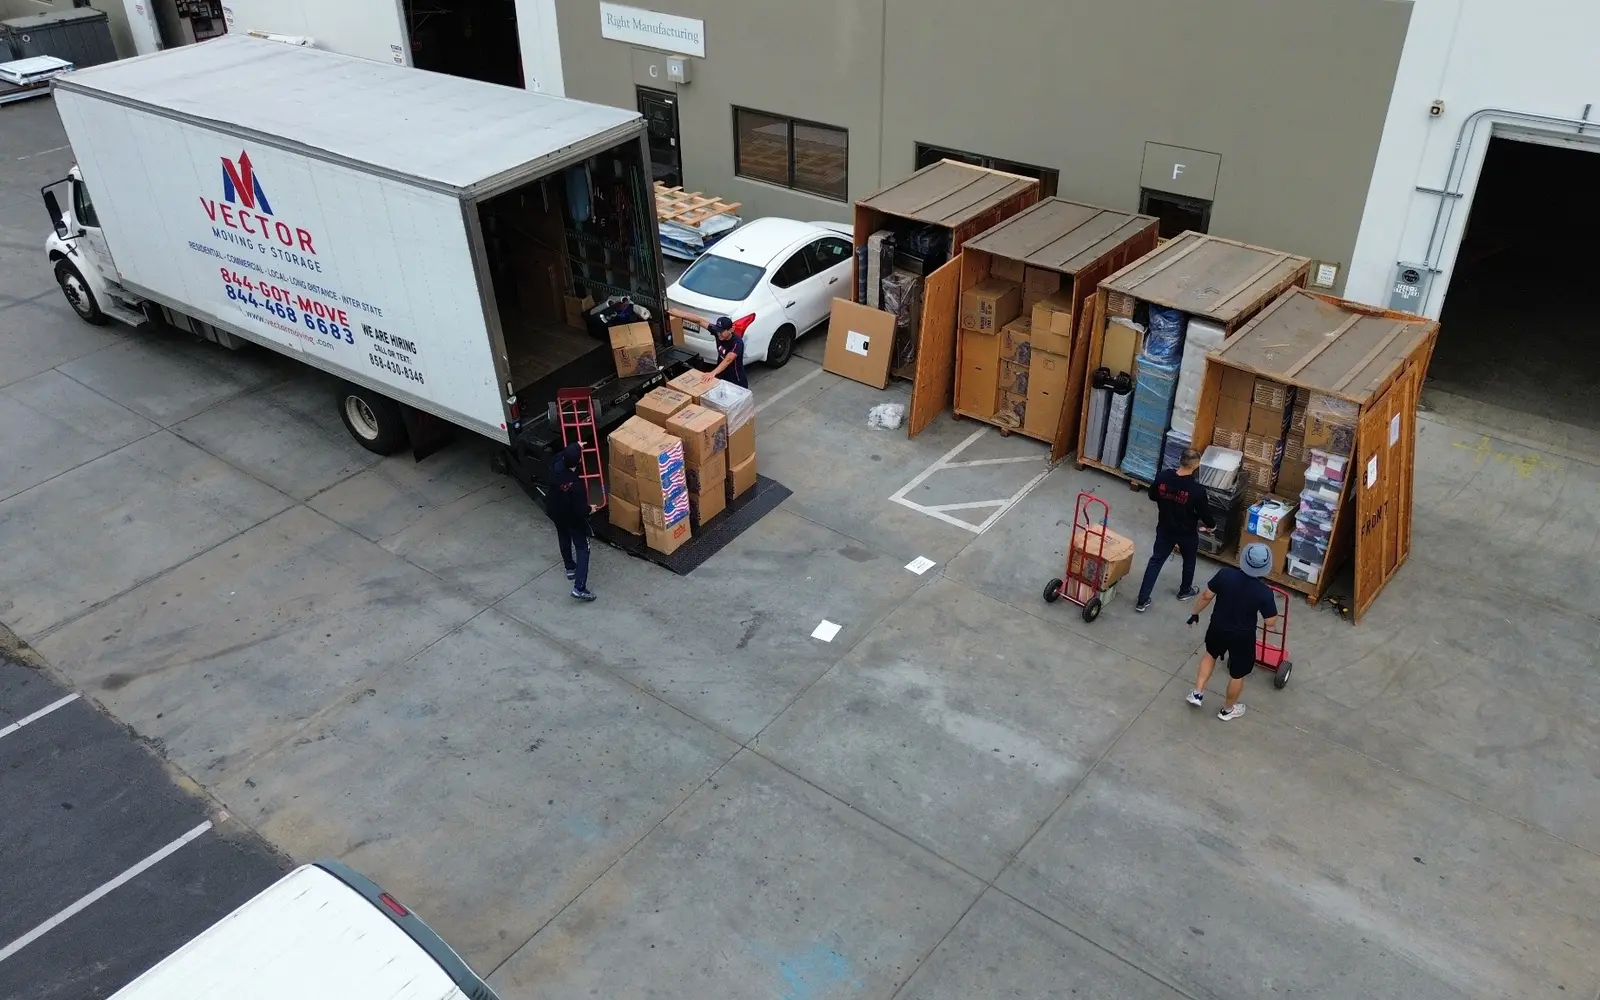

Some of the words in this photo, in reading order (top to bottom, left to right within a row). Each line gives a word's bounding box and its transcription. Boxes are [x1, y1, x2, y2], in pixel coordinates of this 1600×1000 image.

[606, 12, 631, 30] Right
[632, 18, 700, 45] Manufacturing
[1172, 163, 1186, 180] F
[199, 197, 317, 255] VECTOR
[211, 226, 254, 250] MOVING
[258, 243, 266, 254] &
[270, 246, 322, 273] STORAGE
[188, 240, 224, 260] RESIDENTIAL
[226, 253, 264, 274] COMMERCIAL
[268, 267, 287, 282] LOCAL
[289, 275, 307, 290] LONG
[306, 282, 338, 301] DISTANCE
[220, 267, 350, 328] 844-GOT-MOVE
[225, 284, 298, 323] 844-468
[303, 313, 355, 345] 6683
[361, 322, 374, 338] WE
[374, 328, 390, 345] ARE
[390, 333, 417, 355] HIRING
[373, 343, 388, 356] CALL
[387, 349, 397, 359] OR
[368, 352, 425, 385] 858-430-8346
[1361, 500, 1389, 536] FRONT
